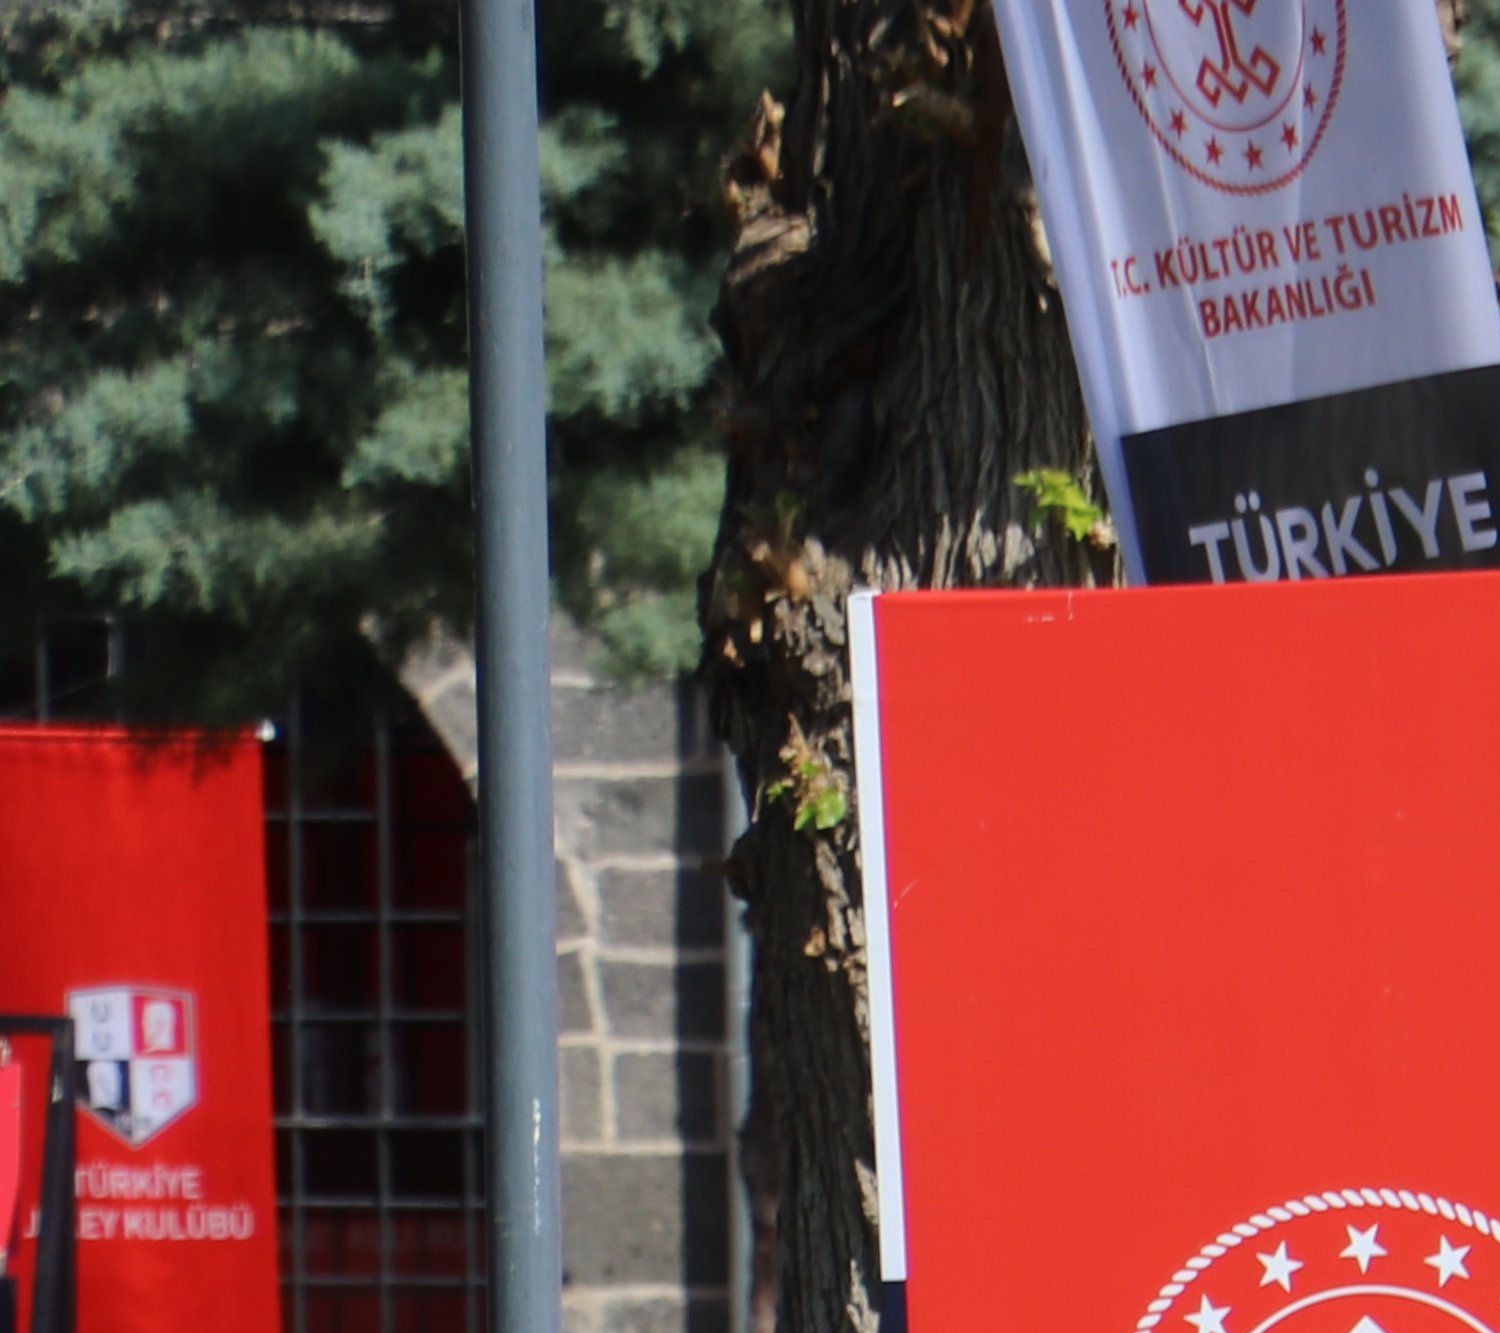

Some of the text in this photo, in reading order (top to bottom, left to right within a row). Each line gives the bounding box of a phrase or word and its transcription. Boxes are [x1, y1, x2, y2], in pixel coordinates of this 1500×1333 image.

[1110, 191, 1465, 298] T.C. KÜLTÜR VE TURİZM
[1198, 265, 1378, 340] BAKANLIĞI
[1188, 467, 1498, 585] TÜRKİYE
[74, 1159, 204, 1200] TÜRKİYE
[23, 1203, 255, 1241] JEY KULÜBÜ
